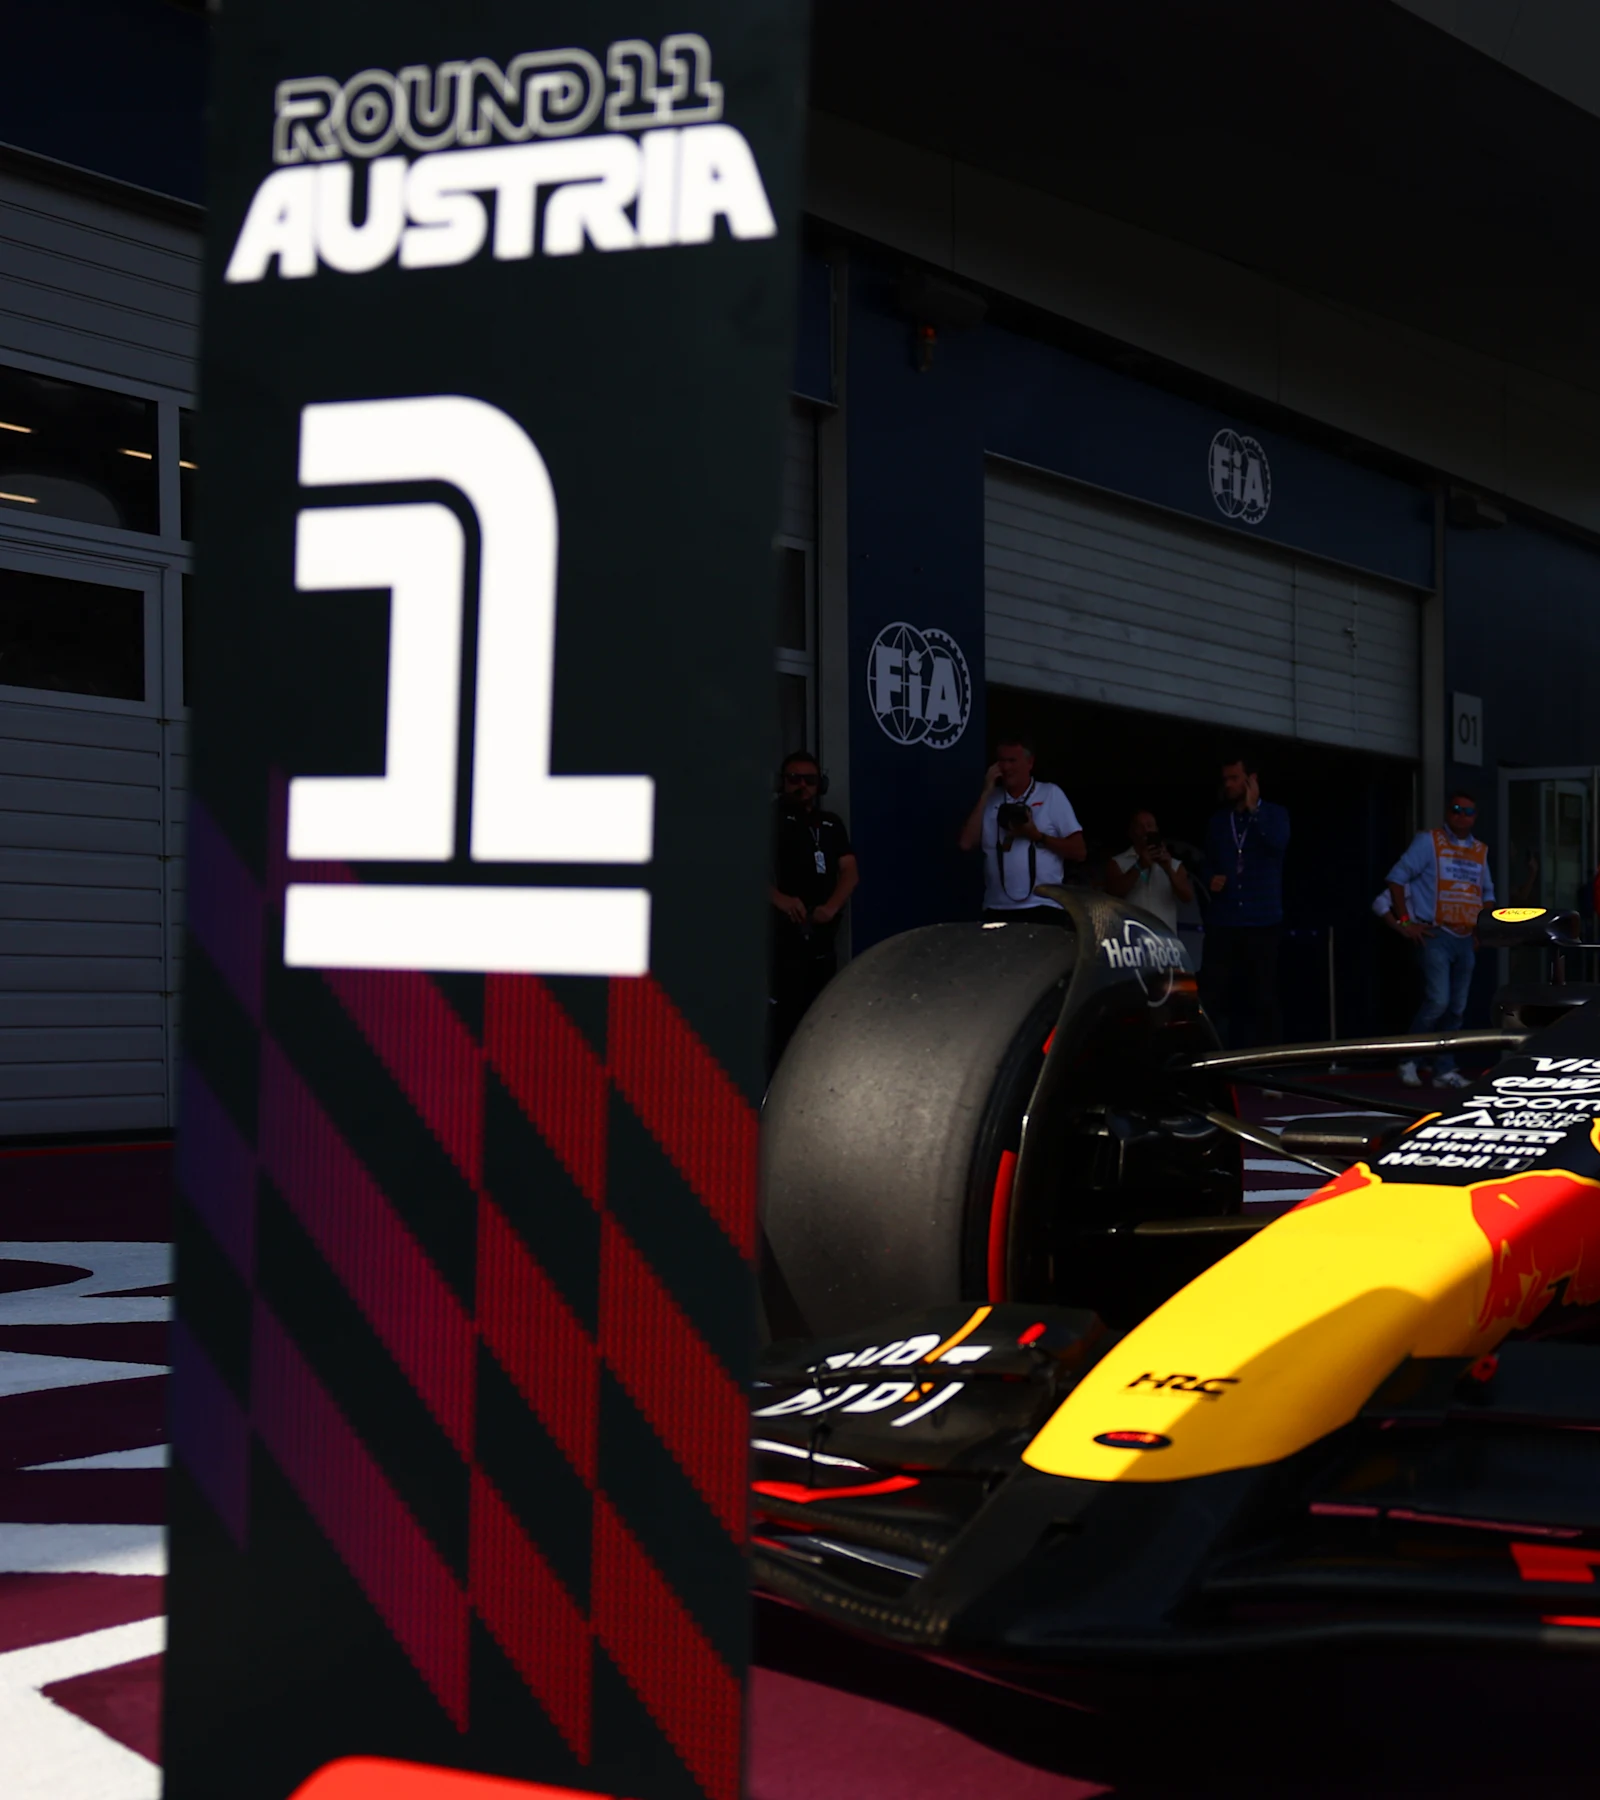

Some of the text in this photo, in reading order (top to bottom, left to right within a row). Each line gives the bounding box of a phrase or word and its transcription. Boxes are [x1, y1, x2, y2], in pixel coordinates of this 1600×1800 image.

[273, 47, 604, 163] ROUND
[223, 124, 778, 283] AUSTRIA
[285, 395, 655, 976] 1
[1458, 713, 1477, 747] 01
[1497, 1111, 1590, 1122] ARCTIC
[1502, 1118, 1574, 1129] WOLF
[1416, 1126, 1567, 1144] PIRELLI
[1399, 1140, 1547, 1156] infinitum
[1378, 1152, 1492, 1169] Mobil
